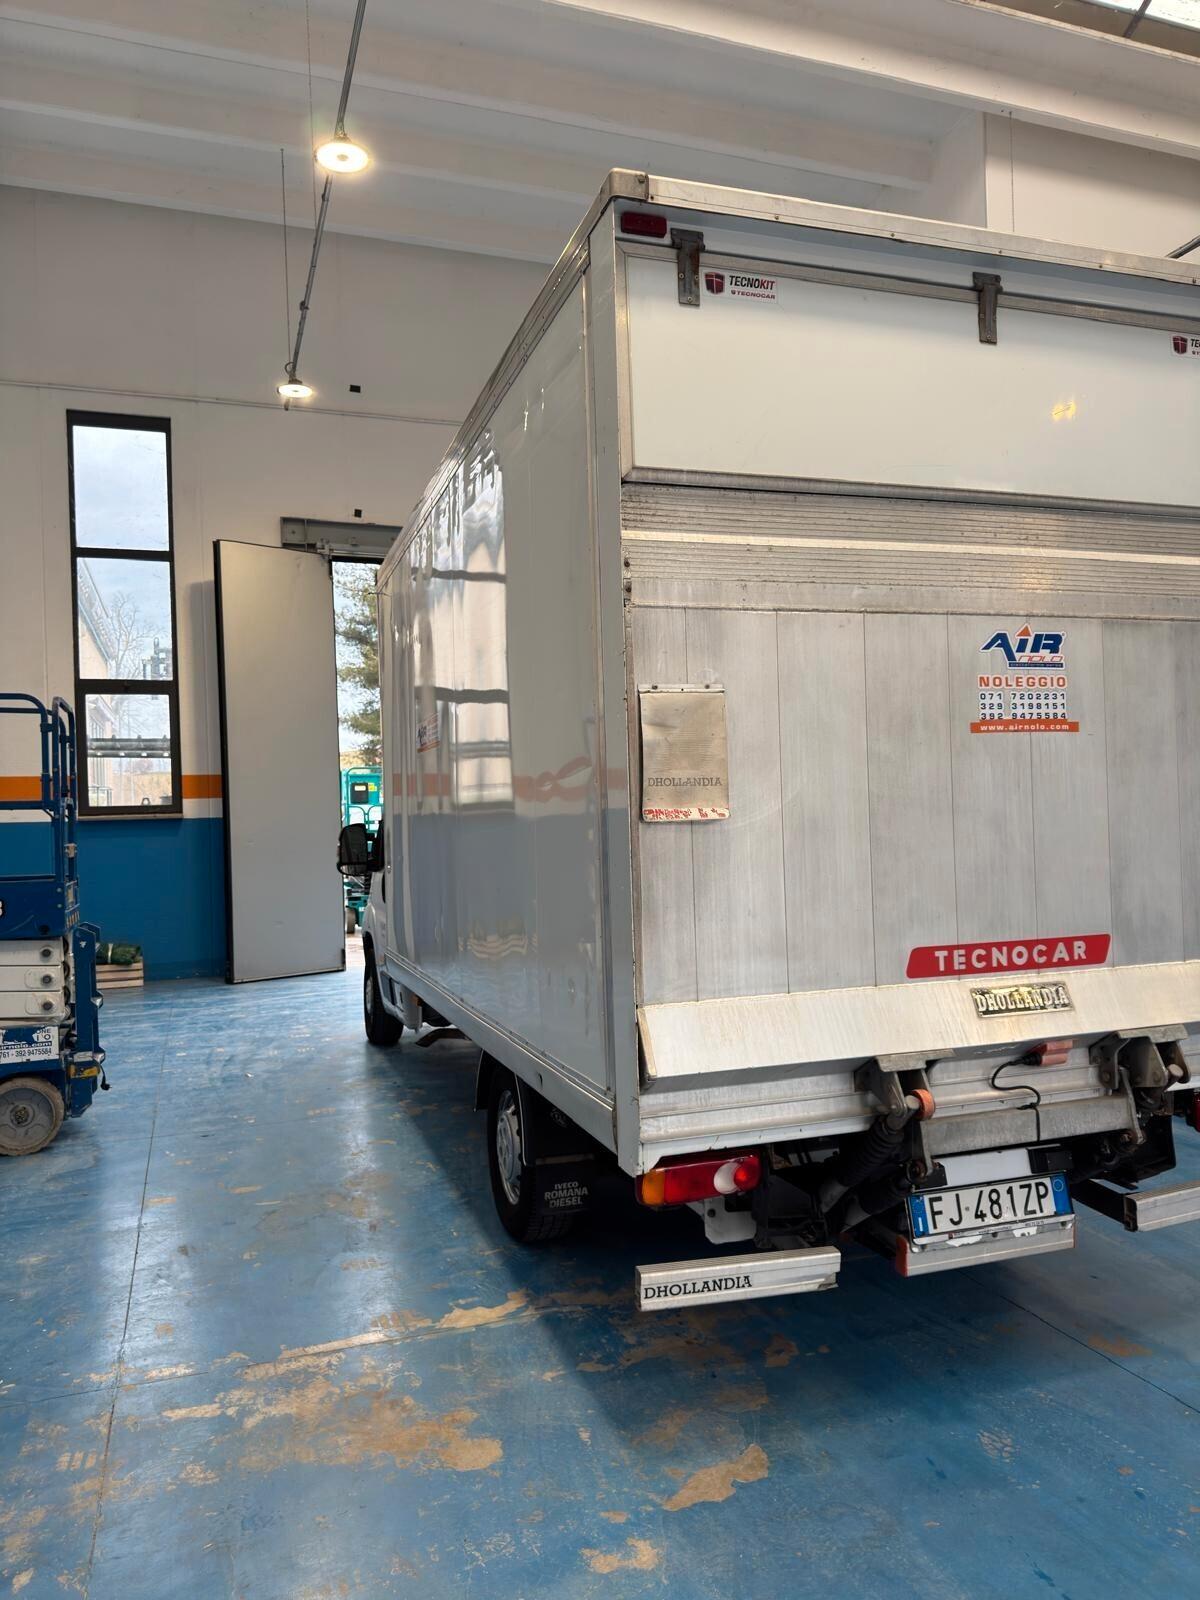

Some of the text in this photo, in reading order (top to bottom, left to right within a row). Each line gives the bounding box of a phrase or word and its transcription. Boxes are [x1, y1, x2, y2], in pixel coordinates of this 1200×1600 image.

[729, 275, 775, 290] TECNOKIT
[737, 290, 775, 299] TECNOCAR
[1190, 338, 1200, 348] TE
[979, 676, 1066, 688] NOLEGGIO
[981, 702, 1066, 710] 329 3198151
[981, 712, 1066, 720] 392 9475584
[980, 723, 1069, 731] www.airnolo.com
[647, 777, 722, 787] DHOLLANDIA
[935, 941, 1087, 971] TECNOCAR
[974, 987, 1070, 1013] DHOLLANDIA
[554, 1181, 579, 1190] IVECO
[544, 1186, 589, 1200] ROMANA
[549, 1196, 582, 1208] DIESEL
[643, 1275, 753, 1300] DHOLLANDIA
